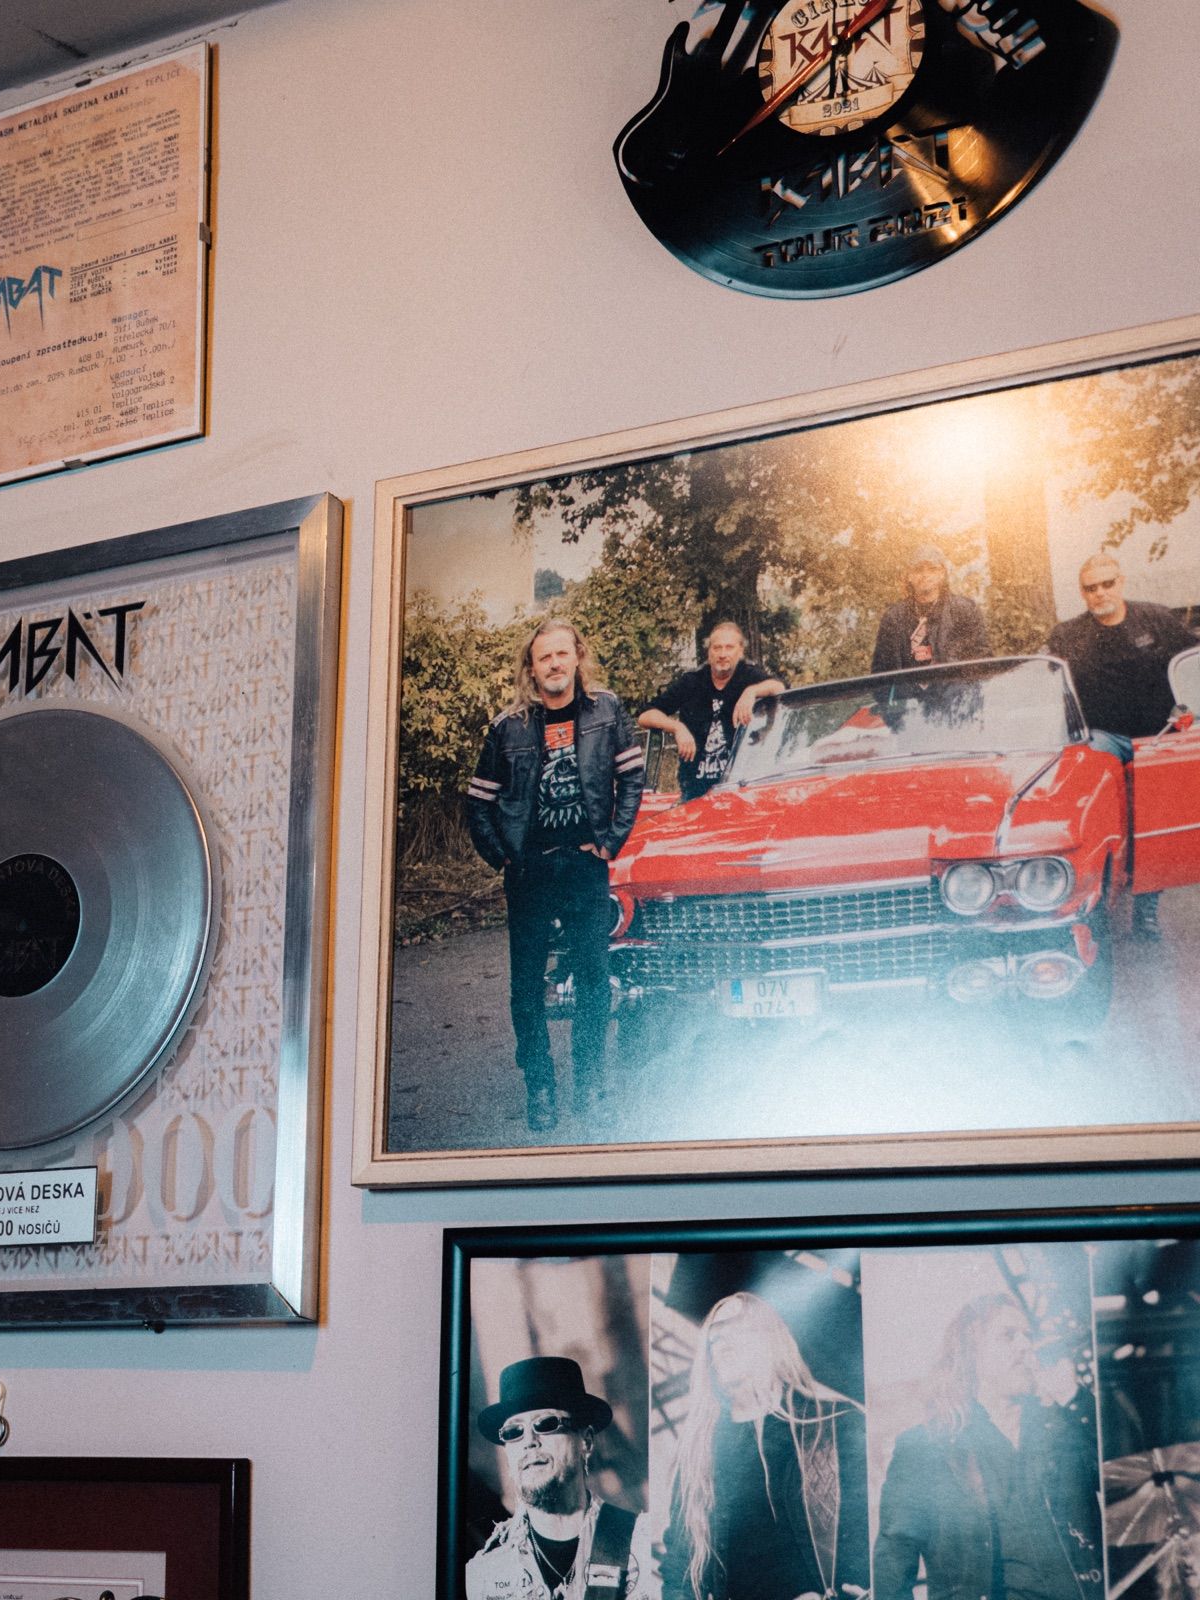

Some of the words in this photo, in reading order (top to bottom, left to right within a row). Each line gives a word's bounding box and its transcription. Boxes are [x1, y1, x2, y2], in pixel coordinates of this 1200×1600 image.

[62, 98, 98, 116] SKUPINA
[822, 98, 860, 118] 2021
[754, 223, 860, 267] TOUR
[111, 339, 145, 353] Rumburk
[111, 395, 143, 409] Teplice
[142, 398, 175, 412] Teplice
[141, 407, 174, 422] Teplice
[30, 1182, 85, 1201] DESKA
